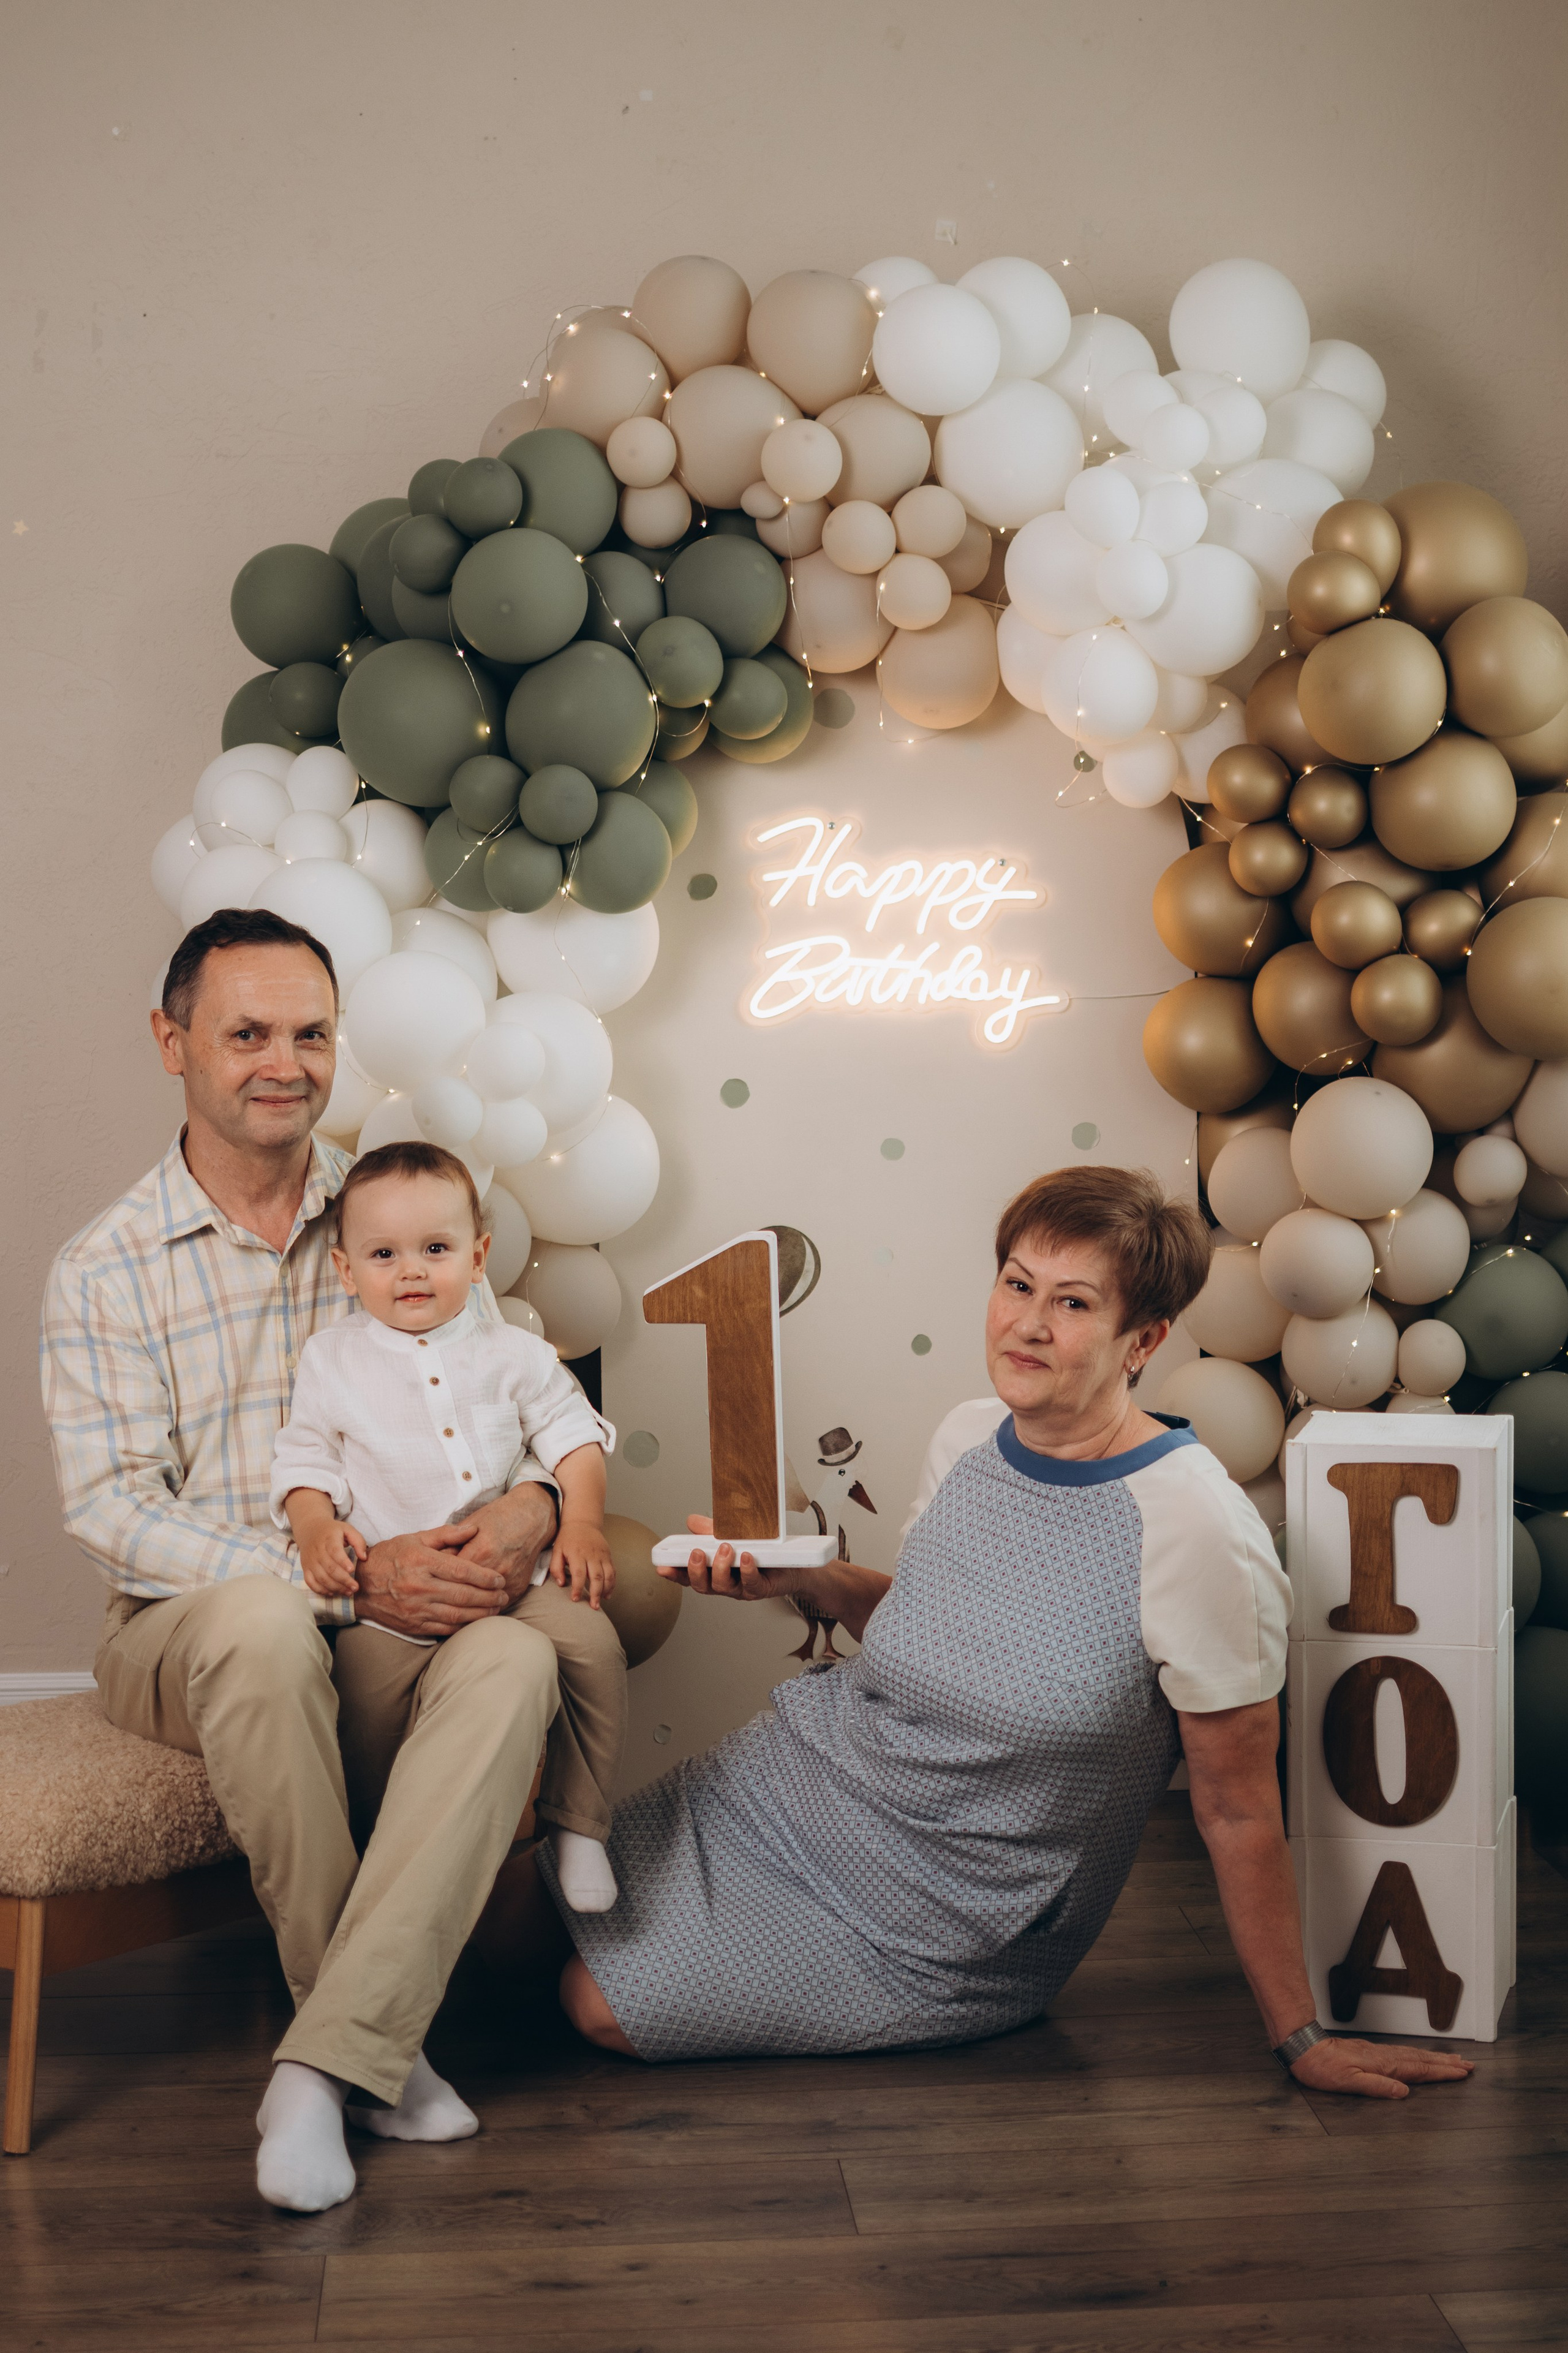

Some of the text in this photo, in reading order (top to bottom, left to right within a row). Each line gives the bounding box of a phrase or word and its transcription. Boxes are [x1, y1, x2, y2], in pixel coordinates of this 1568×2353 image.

[756, 817, 1037, 935] Happy
[750, 935, 1060, 1043] Birthday
[643, 1231, 784, 1541] 1
